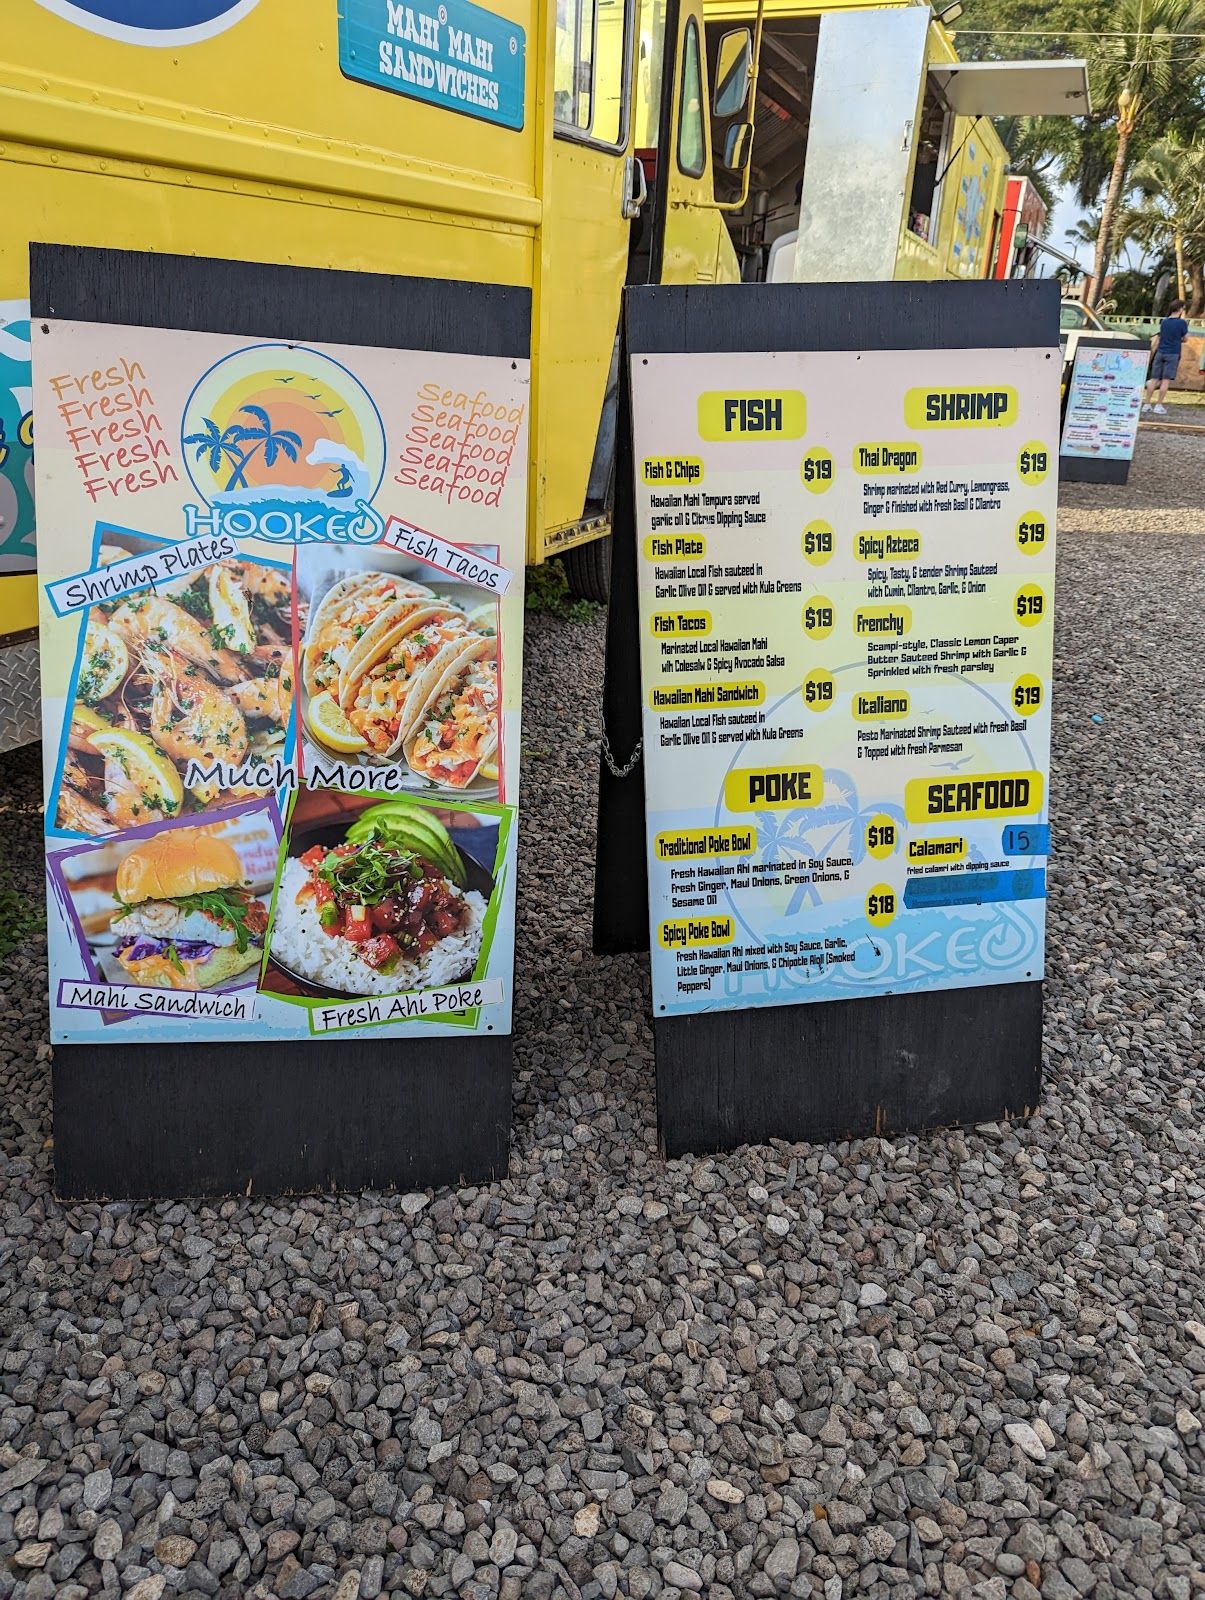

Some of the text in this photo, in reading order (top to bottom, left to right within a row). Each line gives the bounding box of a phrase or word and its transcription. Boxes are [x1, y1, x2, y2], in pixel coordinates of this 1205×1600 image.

[387, 0, 493, 72] MAHI MAHI
[379, 41, 498, 111] SANDWICHES
[49, 358, 146, 400] Fresh
[58, 384, 153, 426] Fresh
[417, 384, 525, 424] Seafood
[725, 399, 782, 431] FISH
[926, 393, 1007, 421] SHRIMP
[67, 410, 162, 452] Fresh
[411, 405, 519, 445] Seafood
[75, 435, 170, 477] Fresh
[406, 426, 513, 466] Seafood
[400, 447, 507, 487] Seafood
[804, 458, 831, 481] $19
[859, 448, 917, 471] Thai Dragon
[1020, 451, 1046, 474] $19
[83, 461, 179, 503] Fresh
[645, 461, 699, 482] Fish & Chips
[394, 468, 501, 507] Seafood
[864, 482, 947, 498] Shrimp with Red
[651, 492, 760, 509] Hawaiian Mahi Tempura served
[864, 500, 932, 517] Ginger with
[692, 511, 766, 528] Citrus Dipping Sauce
[805, 532, 832, 555] $19
[1018, 522, 1044, 544] $19
[395, 528, 499, 587] Fish Tacos
[652, 539, 702, 555] Fish Plate
[859, 535, 919, 559] Spicy Azteca
[66, 537, 234, 607] Shrimp Plates
[655, 564, 754, 579] Hawaiian Local Fish sauteed
[919, 563, 997, 578] tender Shrimp Sauteed
[656, 581, 801, 598] Garlic Olive Oil served with Kula Greens
[868, 582, 986, 598] with Onion
[1017, 595, 1043, 617] $19
[655, 615, 706, 632] Fish Tacos
[805, 607, 832, 629] $19
[857, 613, 903, 635] Frenchy
[661, 638, 767, 654] Marinated Local Hawaiian Mahi
[931, 636, 1019, 649] Classic Lemon Caper
[714, 655, 785, 673] Spicy Avocado Salsa
[868, 648, 1018, 665] Butter Sauteed Shrimp with Garlic
[868, 662, 994, 680] Sprinkled with parsley
[654, 685, 758, 705] Hawaiian Mahi Sandwich
[806, 681, 832, 703] $19
[1015, 686, 1040, 707] $19
[859, 696, 907, 714] Italiano
[660, 713, 757, 729] Hawaiian Local Fish sauteed
[858, 722, 988, 741] Pesto Marinated Shrimp Sauteed with
[661, 728, 803, 746] Garlic Olive Oil served with Kula Greens
[865, 742, 962, 760] Topped with Parmesan
[187, 760, 400, 790] Much More
[749, 772, 811, 803] POKE
[928, 779, 1029, 814] SEAFOOD
[659, 833, 751, 857] Traditional Poke Bowl
[868, 826, 894, 848] $18
[909, 838, 962, 857] Calamari
[1009, 831, 1030, 850] 15
[671, 860, 824, 879] Fresh Hawaiian Ahi marinated Soy
[950, 860, 1009, 872] with dipping sauce
[671, 875, 809, 893] Fresh Maui Green
[672, 895, 717, 908] Sesame Oil
[868, 895, 894, 917] $18
[663, 920, 730, 945] Spicy Poke Bowl
[677, 943, 797, 962] Fresh Hawaiian Ahi mixed with Soy
[677, 958, 808, 977] Little Maui Chipotle
[71, 985, 245, 1018] Mahi Sandwich
[322, 987, 483, 1030] Fresh Ahi Poke
